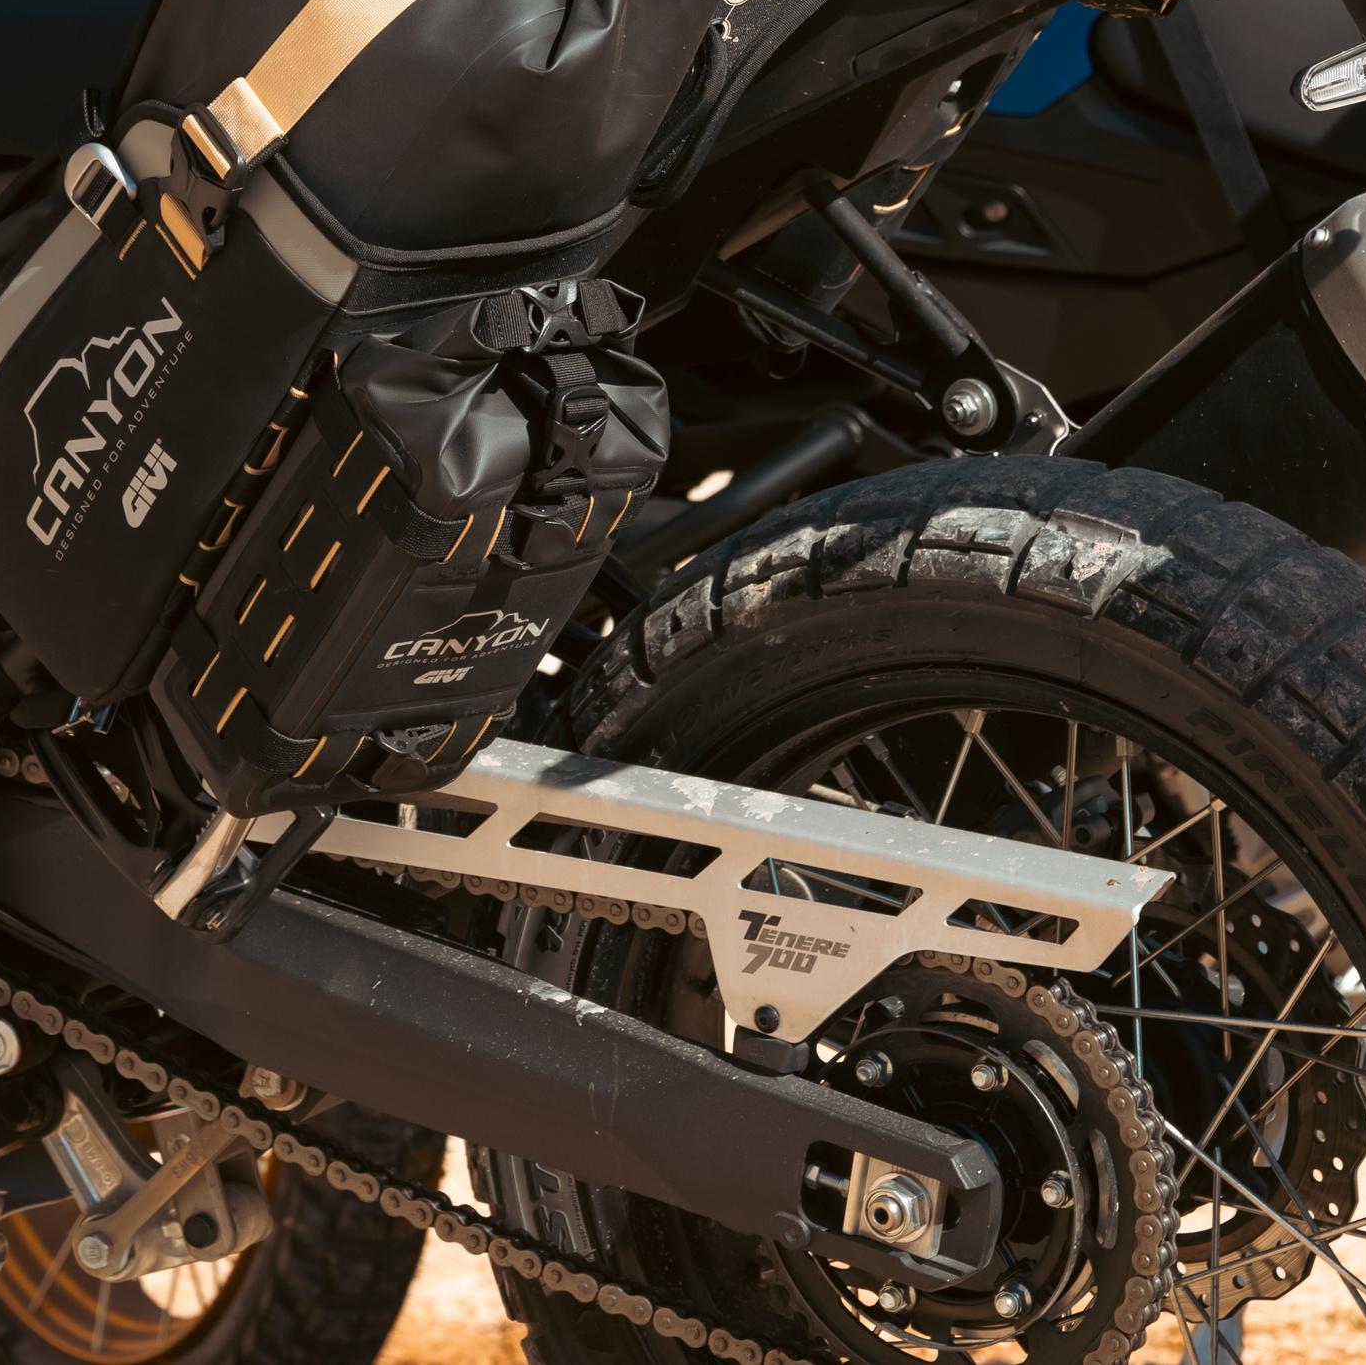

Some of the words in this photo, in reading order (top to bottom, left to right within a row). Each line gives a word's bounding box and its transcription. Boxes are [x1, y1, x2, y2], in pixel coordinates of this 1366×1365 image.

[26, 296, 183, 545] CANYON
[55, 478, 102, 561] DESIGNED
[103, 439, 126, 473] FOR
[127, 330, 194, 434] ADVENTURE
[122, 440, 177, 528] GIVI
[376, 658, 439, 669] DESIGNED
[443, 655, 468, 663] FOR
[471, 640, 537, 659] ADVENTURE
[384, 618, 550, 660] CANYON
[413, 666, 473, 684] GIVI
[742, 943, 818, 974] 700
